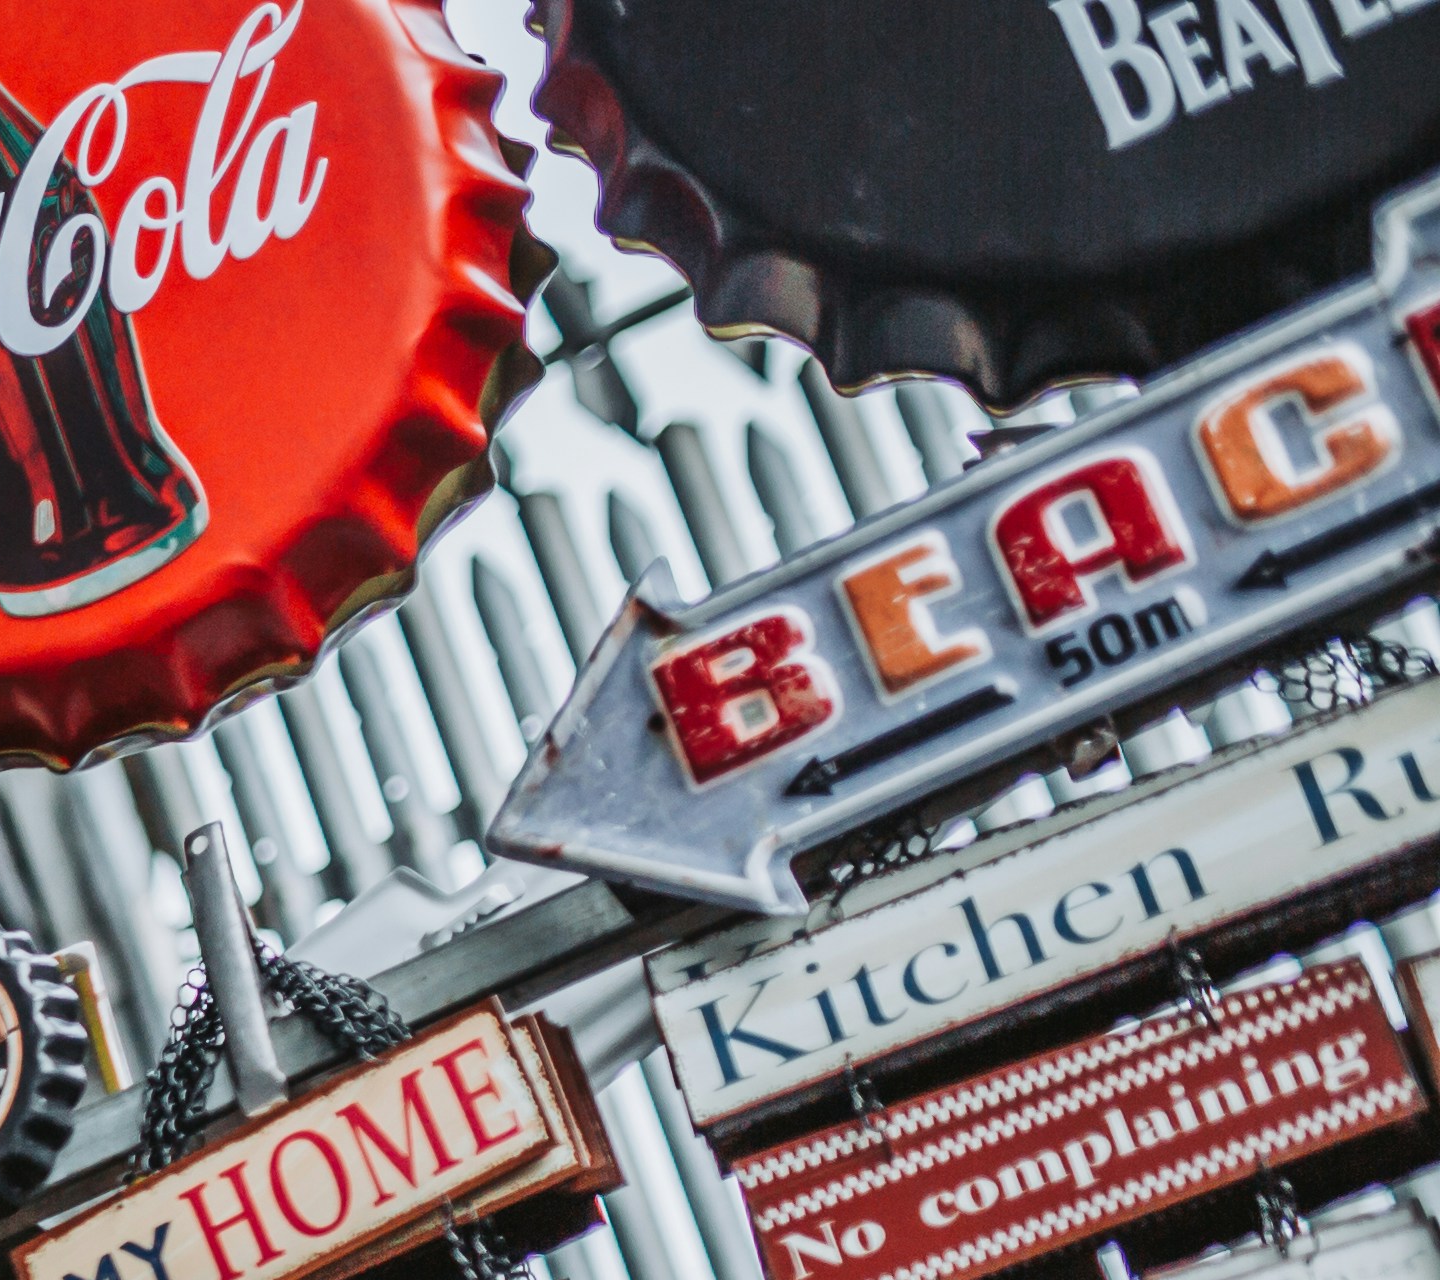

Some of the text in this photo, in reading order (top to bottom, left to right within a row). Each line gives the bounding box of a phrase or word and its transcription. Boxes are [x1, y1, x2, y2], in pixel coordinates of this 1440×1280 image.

[650, 300, 1440, 792] BEAC
[1045, 598, 1192, 688] 50m
[694, 841, 1218, 1092] Kitchen
[919, 1028, 1371, 1230] complaining
